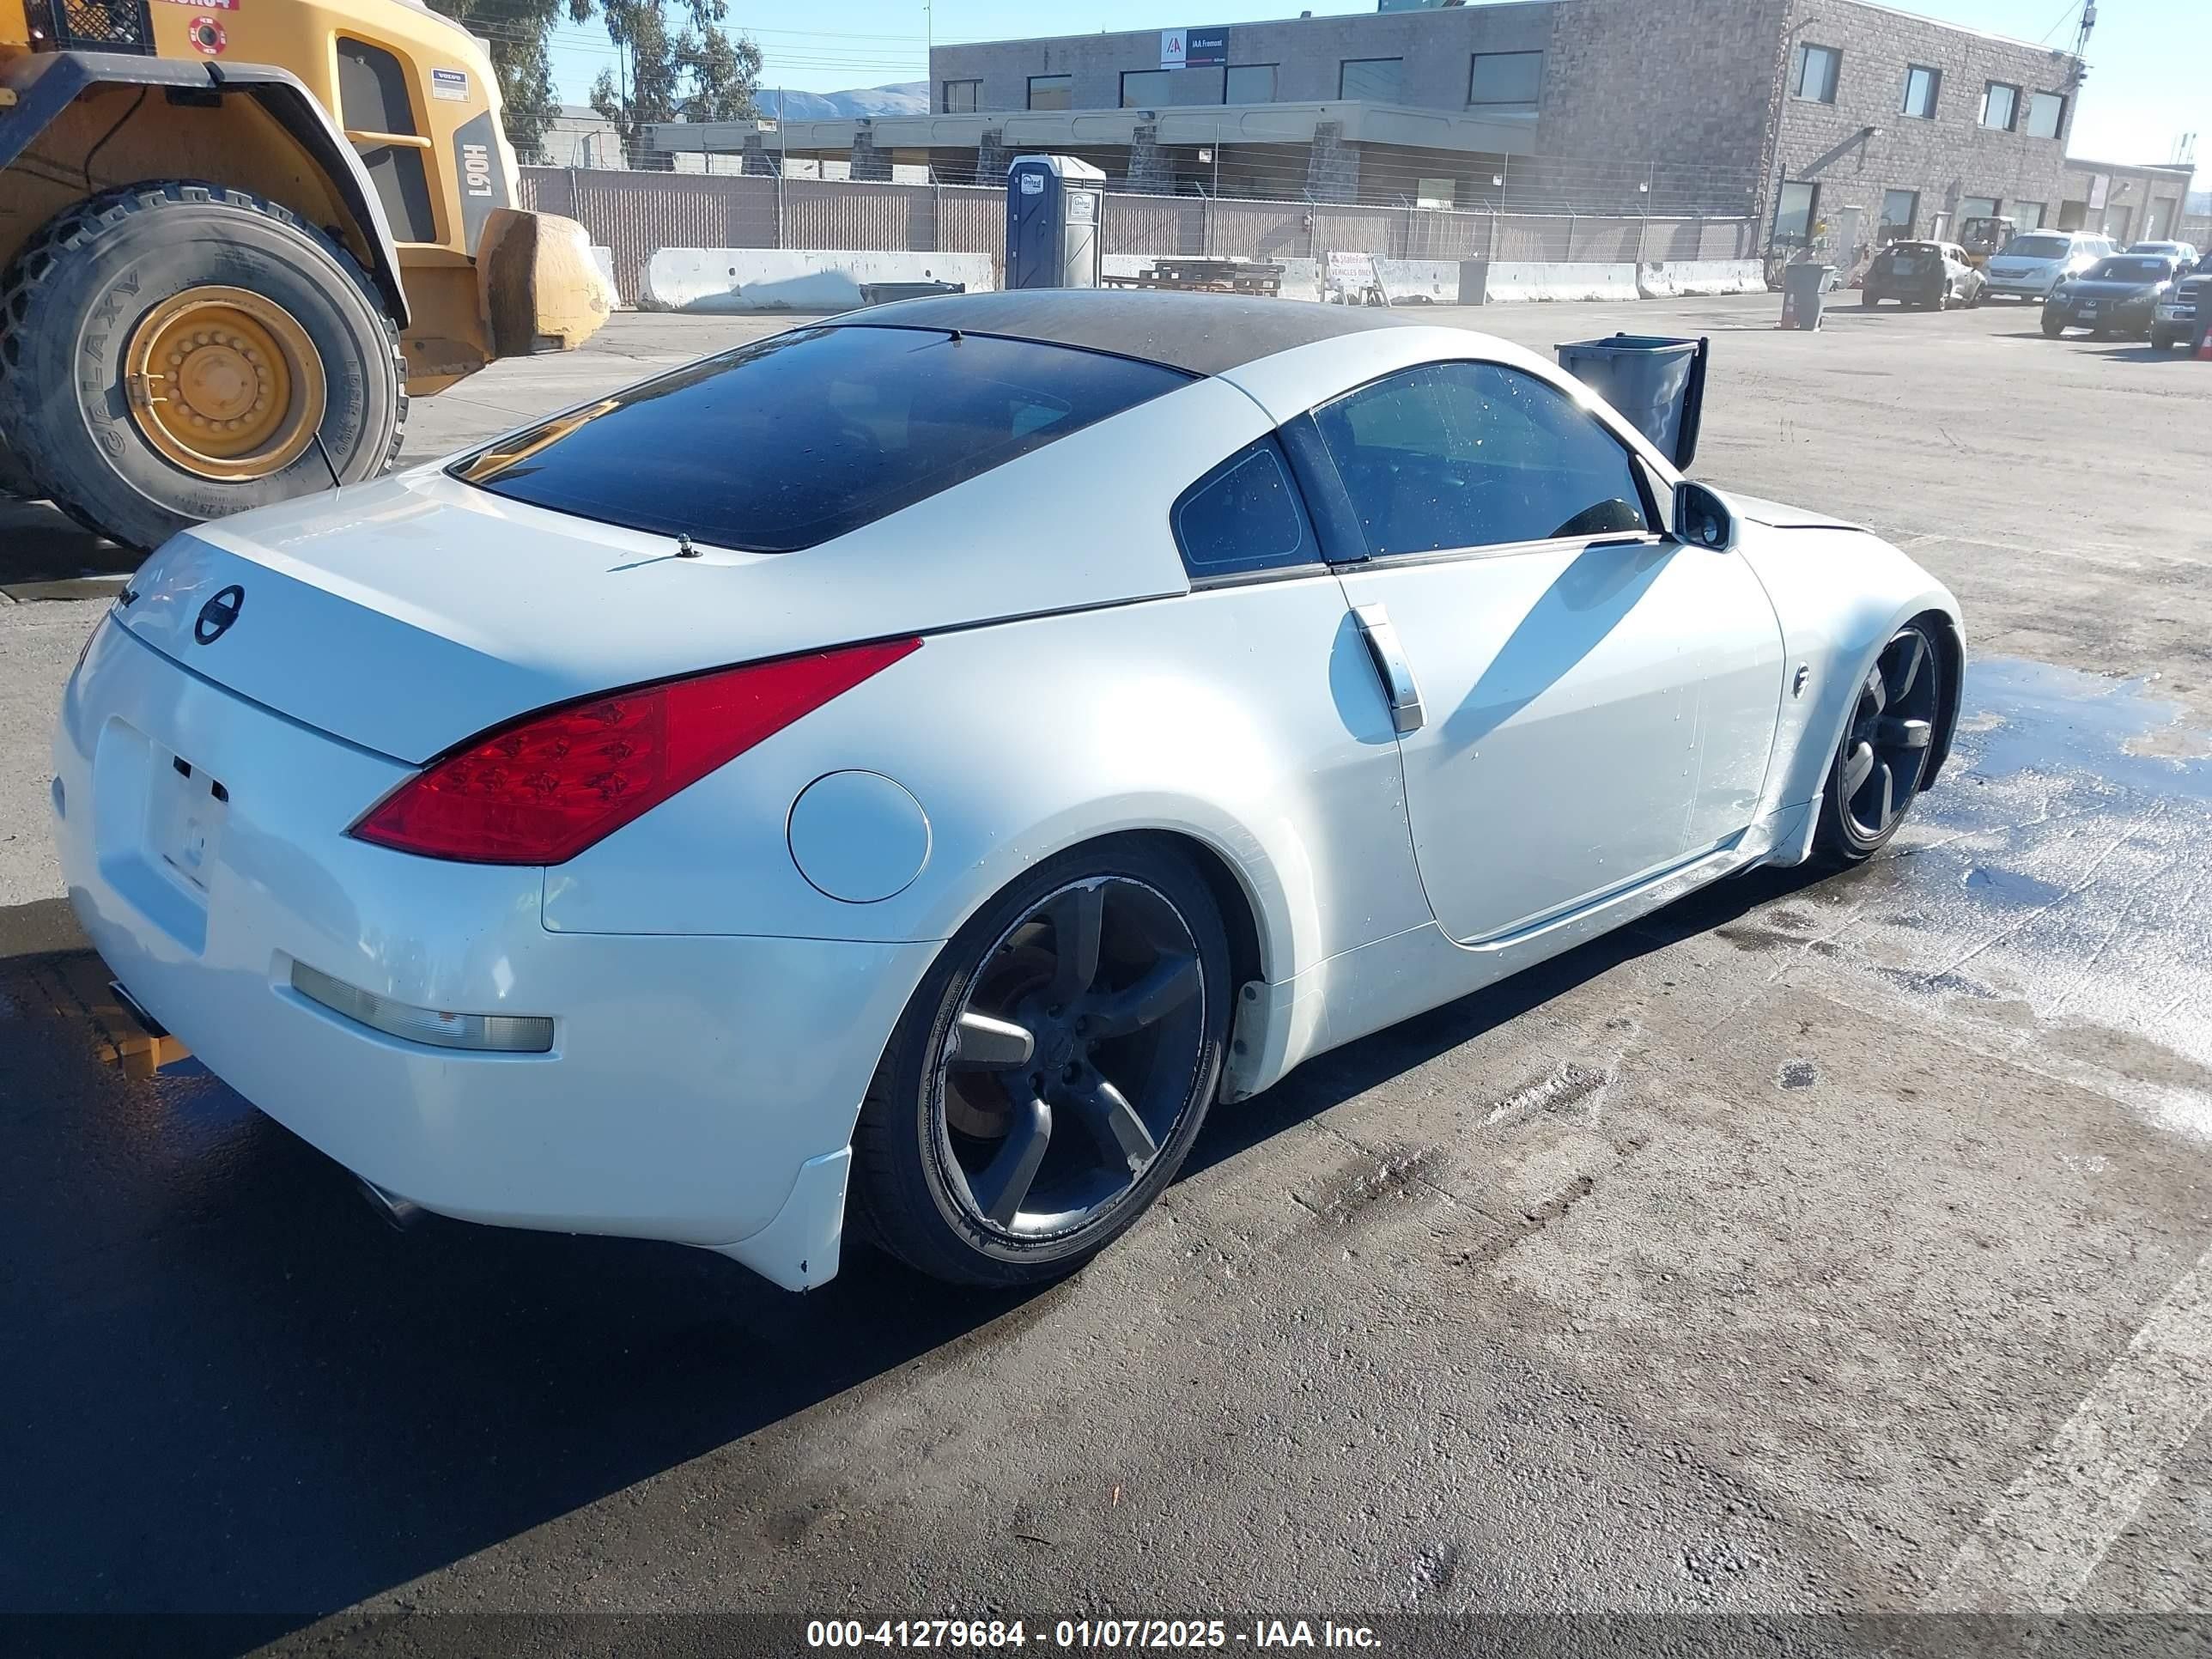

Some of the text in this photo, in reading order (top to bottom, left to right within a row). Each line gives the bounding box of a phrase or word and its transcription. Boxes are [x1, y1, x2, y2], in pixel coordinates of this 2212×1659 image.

[1202, 39, 1223, 47] Fremont
[462, 144, 492, 197] L90H
[1023, 178, 1042, 187] United
[1331, 268, 1358, 276] VEHICLES
[83, 269, 142, 459] GALAXY
